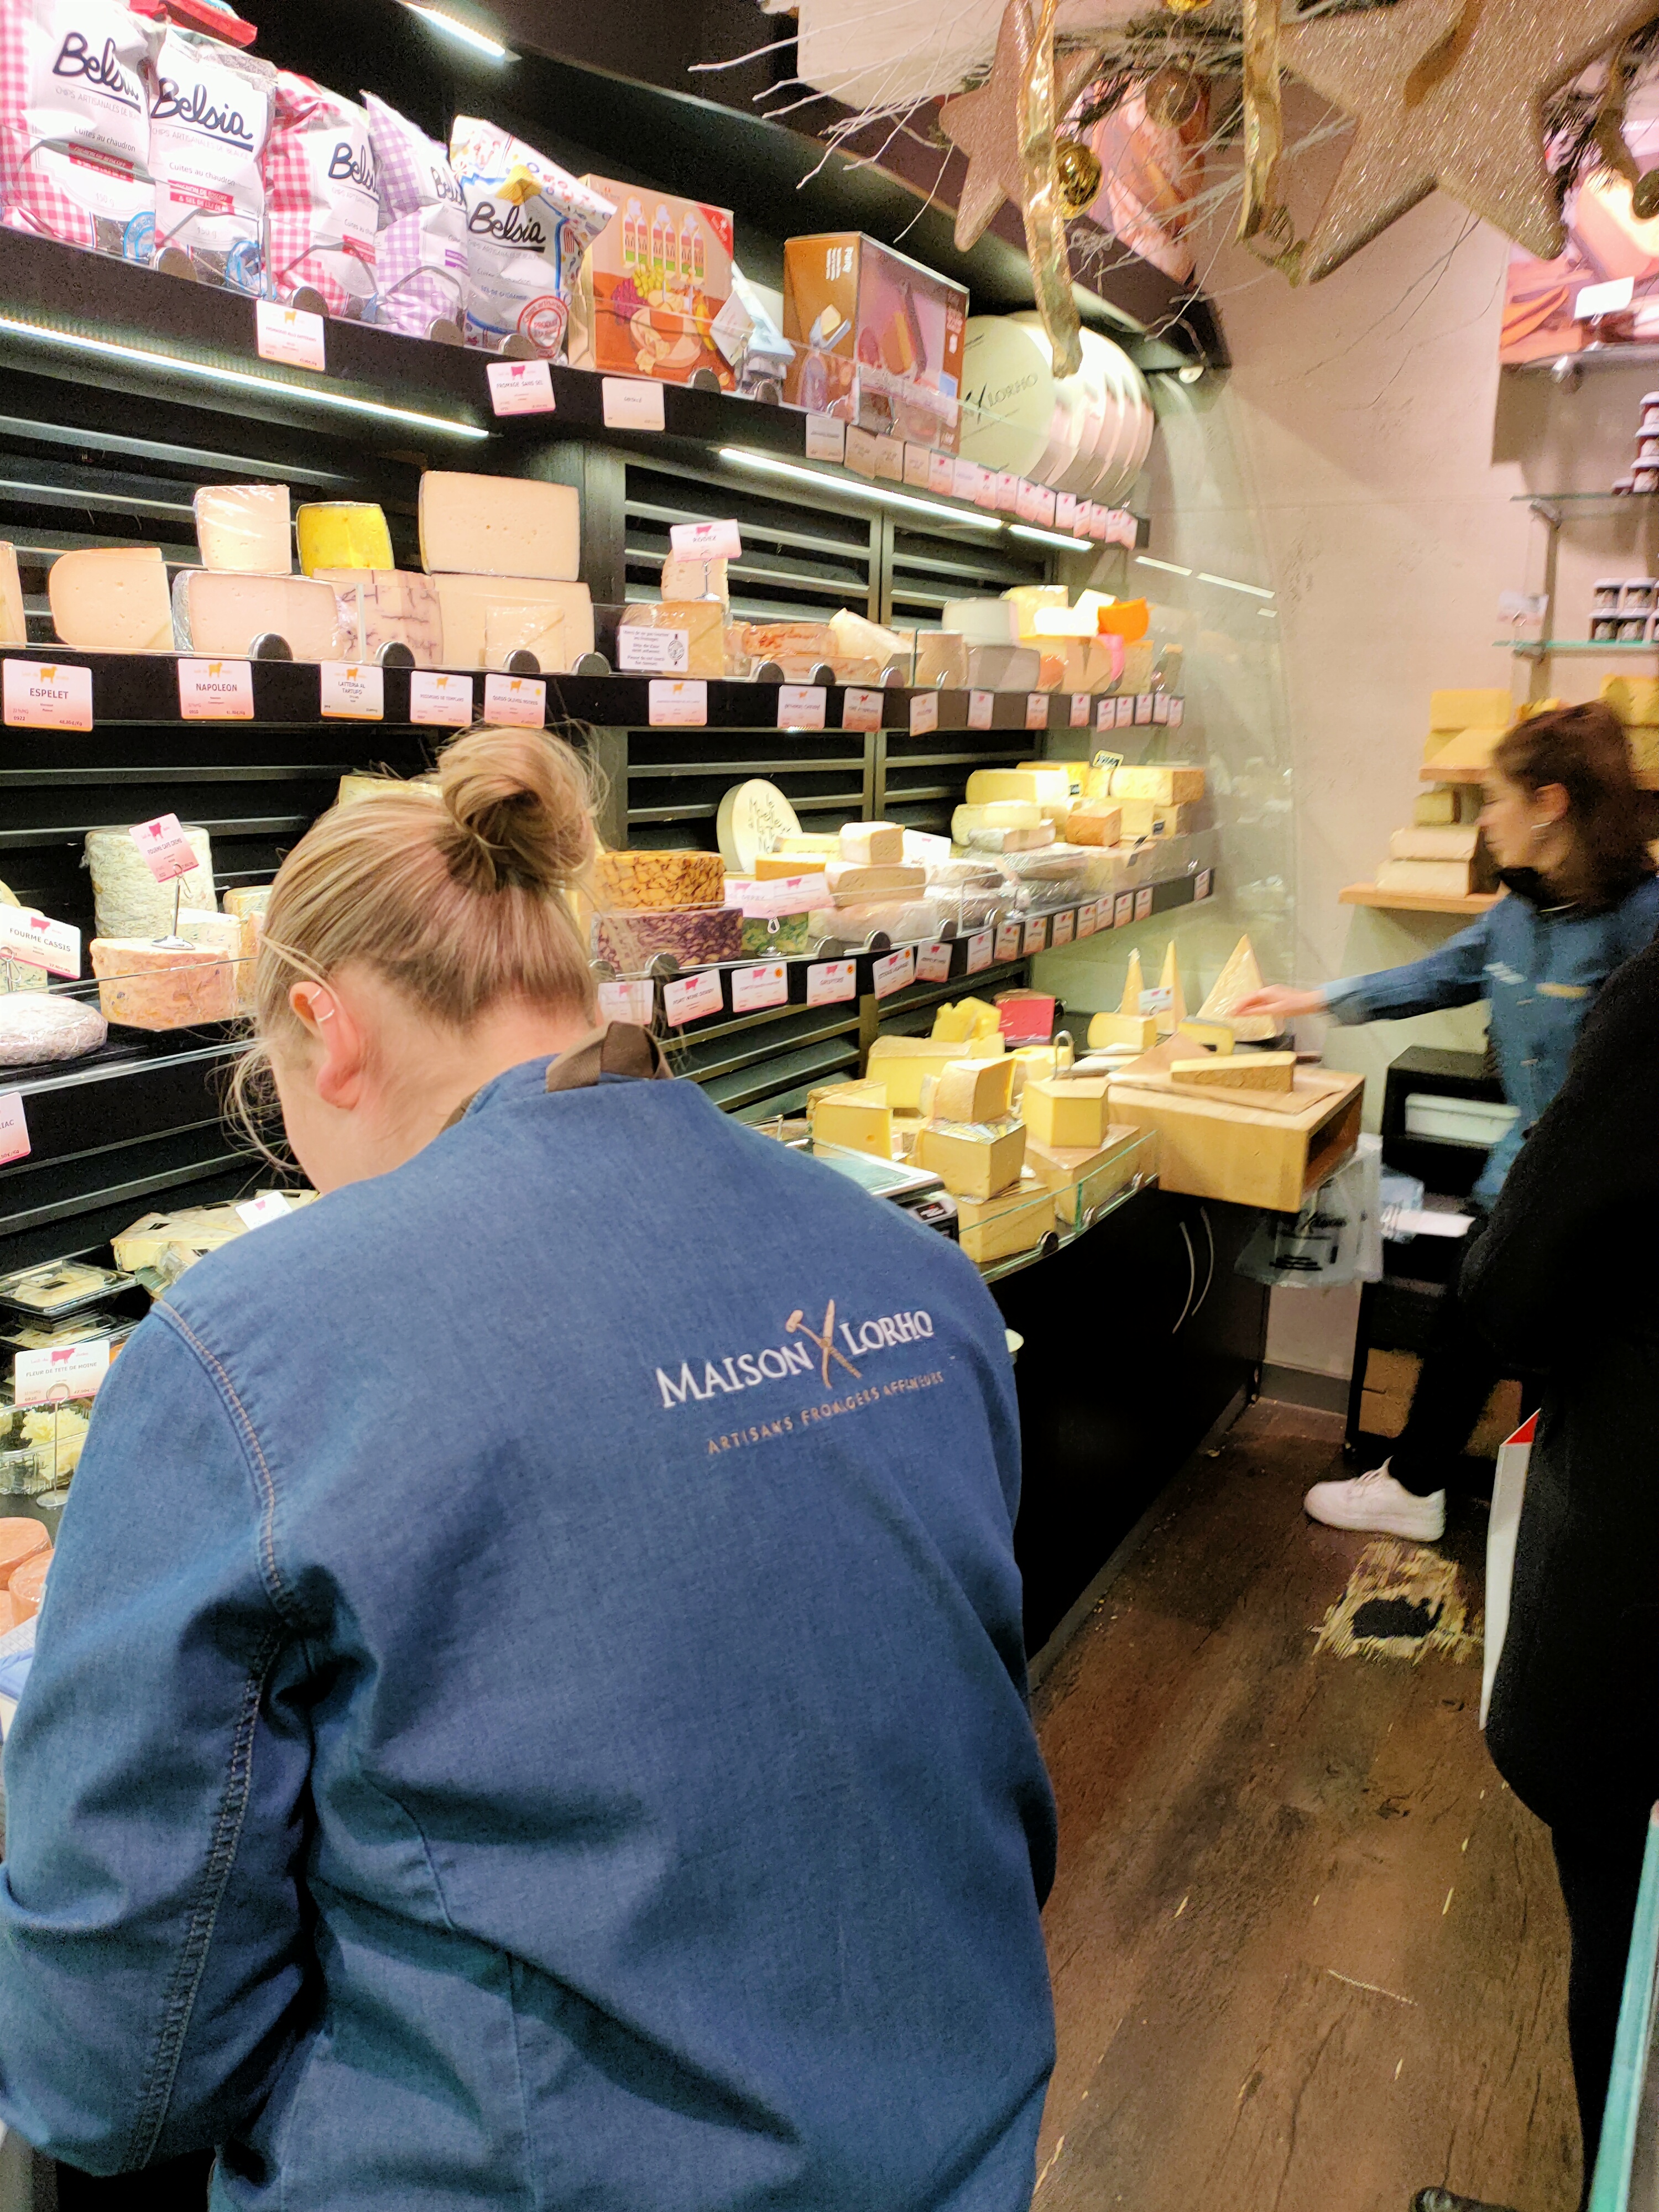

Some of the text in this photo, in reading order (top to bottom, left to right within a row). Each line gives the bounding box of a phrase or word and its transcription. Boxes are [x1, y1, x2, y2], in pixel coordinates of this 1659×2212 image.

[150, 77, 253, 140] Belsia
[97, 134, 106, 142] au
[106, 137, 136, 153] chaudron
[169, 162, 193, 174] Cuites
[205, 171, 236, 186] chaudron
[469, 201, 546, 244] Belsia
[988, 372, 1039, 408] LORHO
[30, 687, 69, 700] ESPELET
[9, 927, 71, 952] FOURME CASSIS
[0, 1119, 14, 1128] IAC
[655, 1310, 935, 1408] MAISON LORHO
[707, 1416, 794, 1455] ARTISANS
[883, 1371, 945, 1396] AFFINEURS
